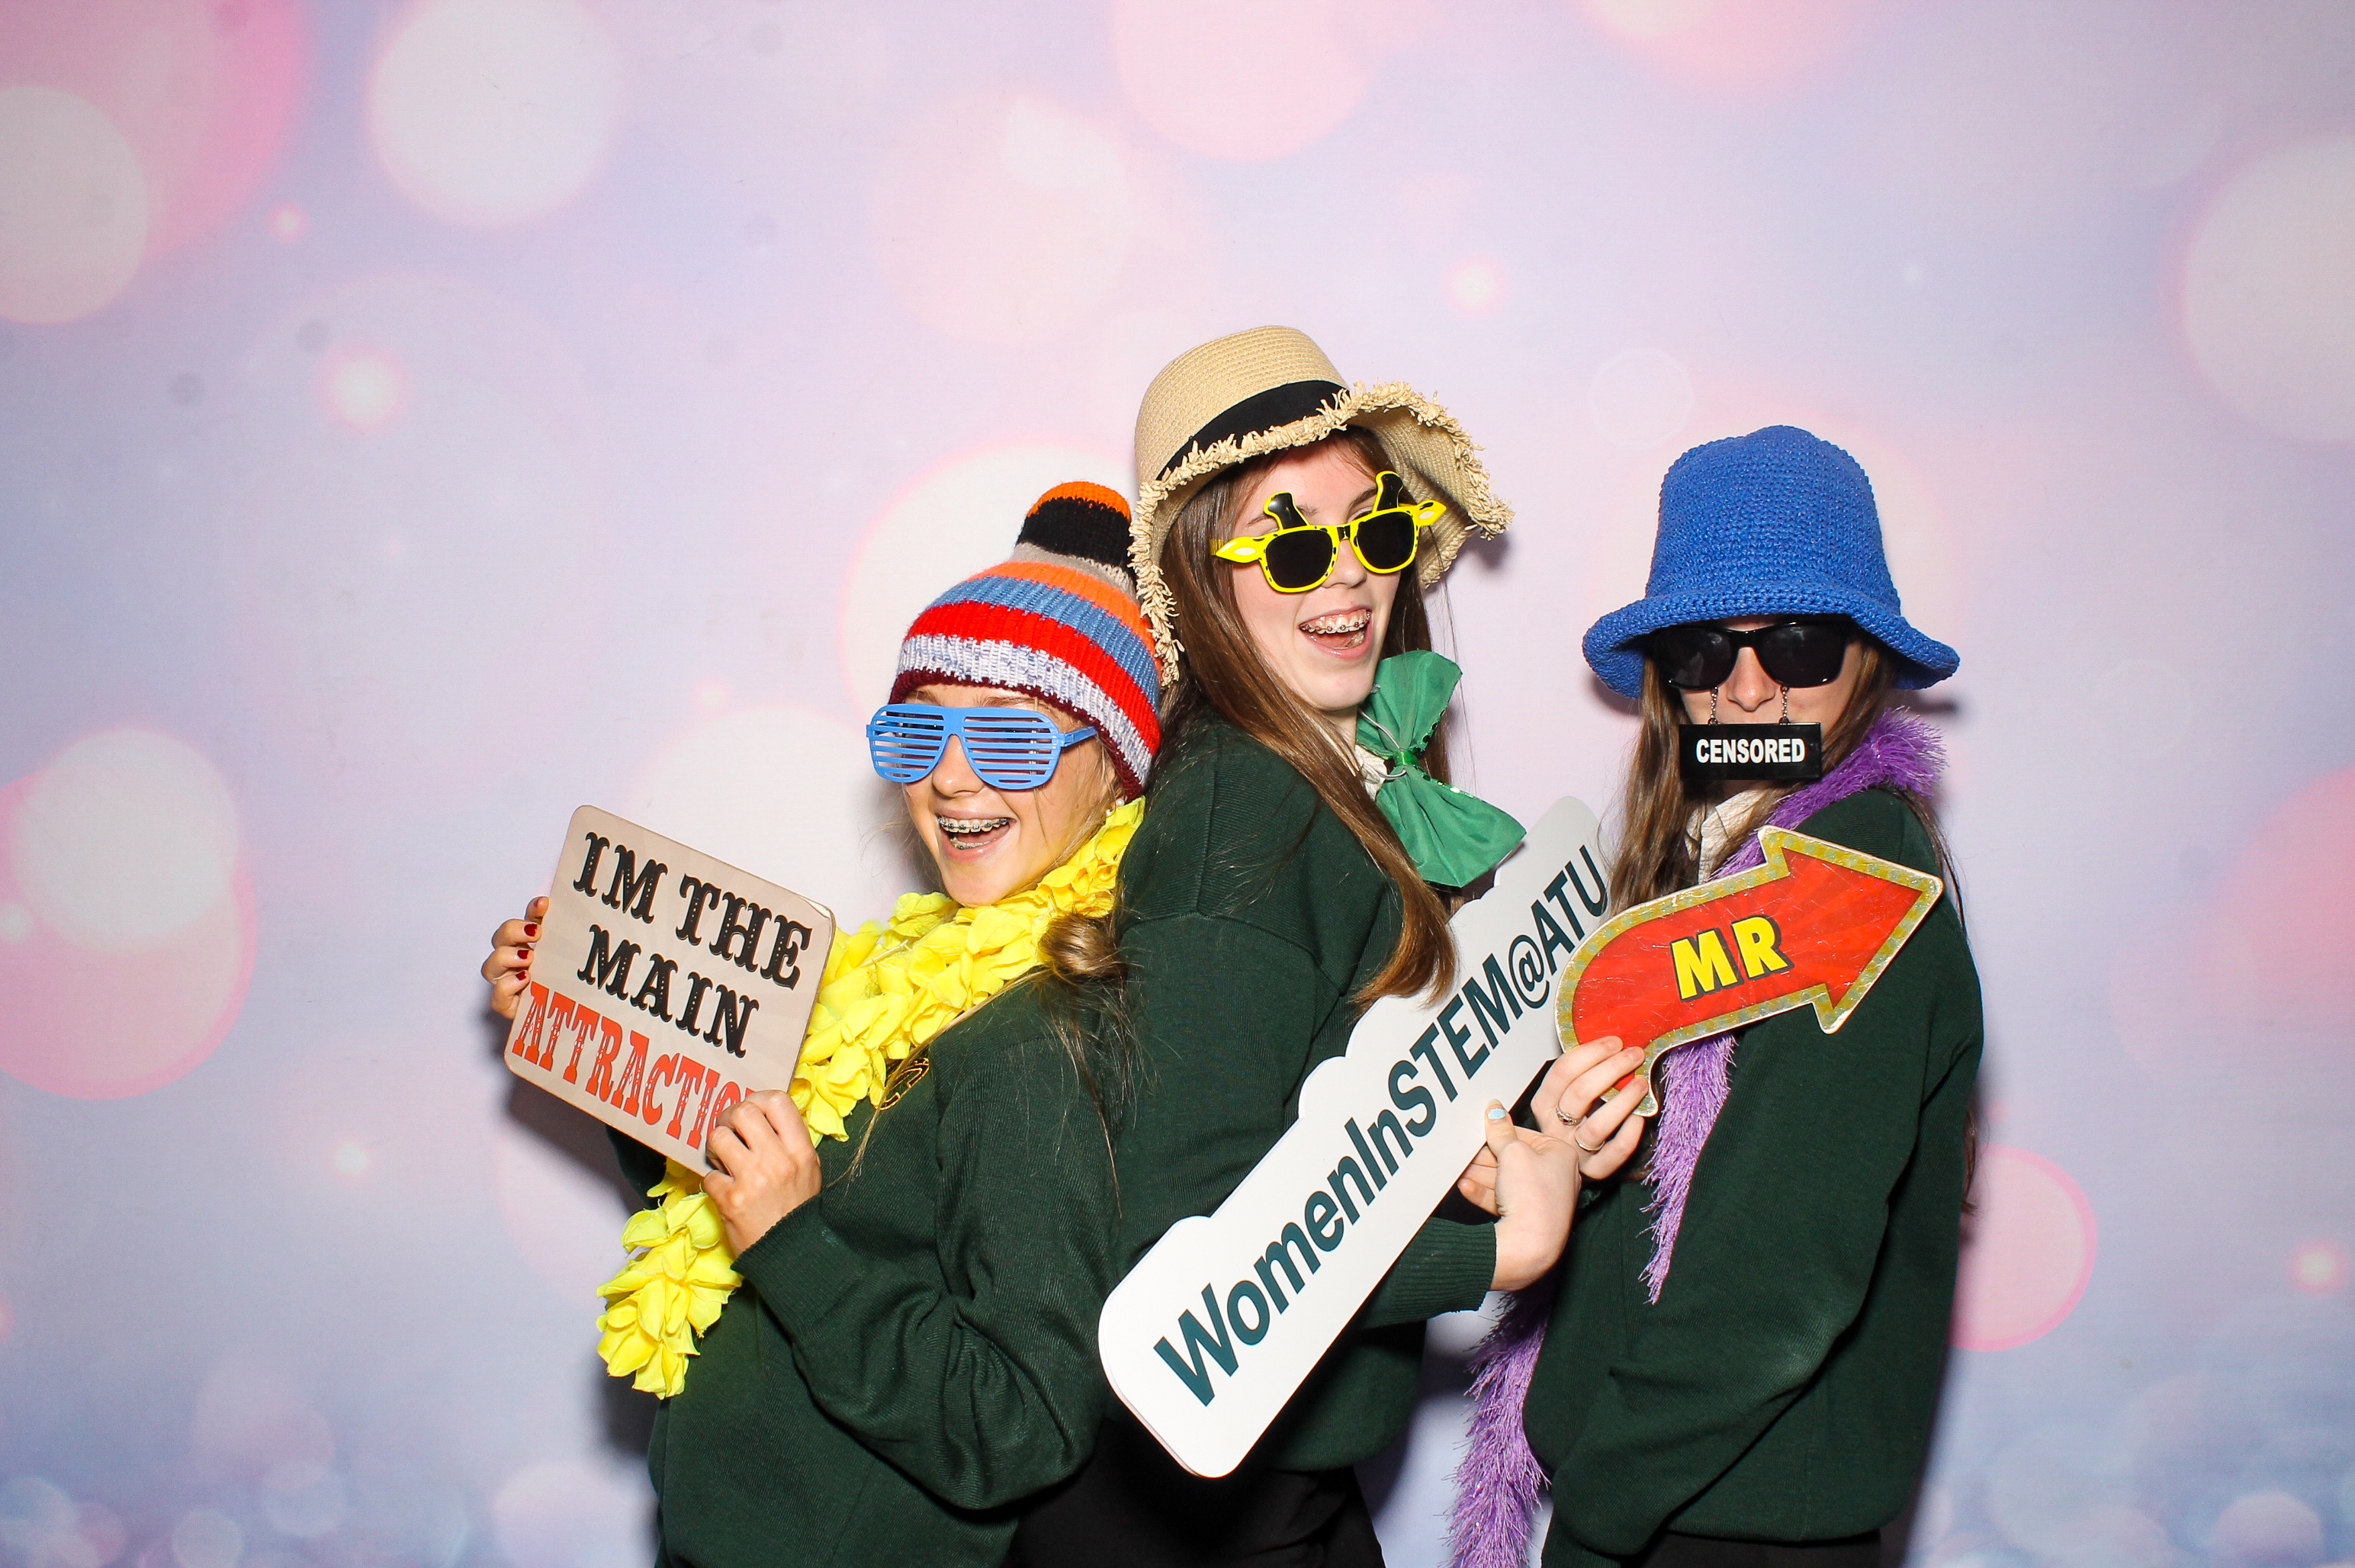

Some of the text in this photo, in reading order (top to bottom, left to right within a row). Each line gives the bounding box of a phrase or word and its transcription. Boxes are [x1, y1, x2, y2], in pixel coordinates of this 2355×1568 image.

[1696, 738, 1805, 763] CENSORED
[573, 831, 813, 991] IM THE
[1670, 916, 1794, 1001] MR
[577, 924, 760, 1058] MAIN
[512, 982, 756, 1149] ATTRACTIO
[1153, 845, 1608, 1406] WomenInSTEM@ATU
